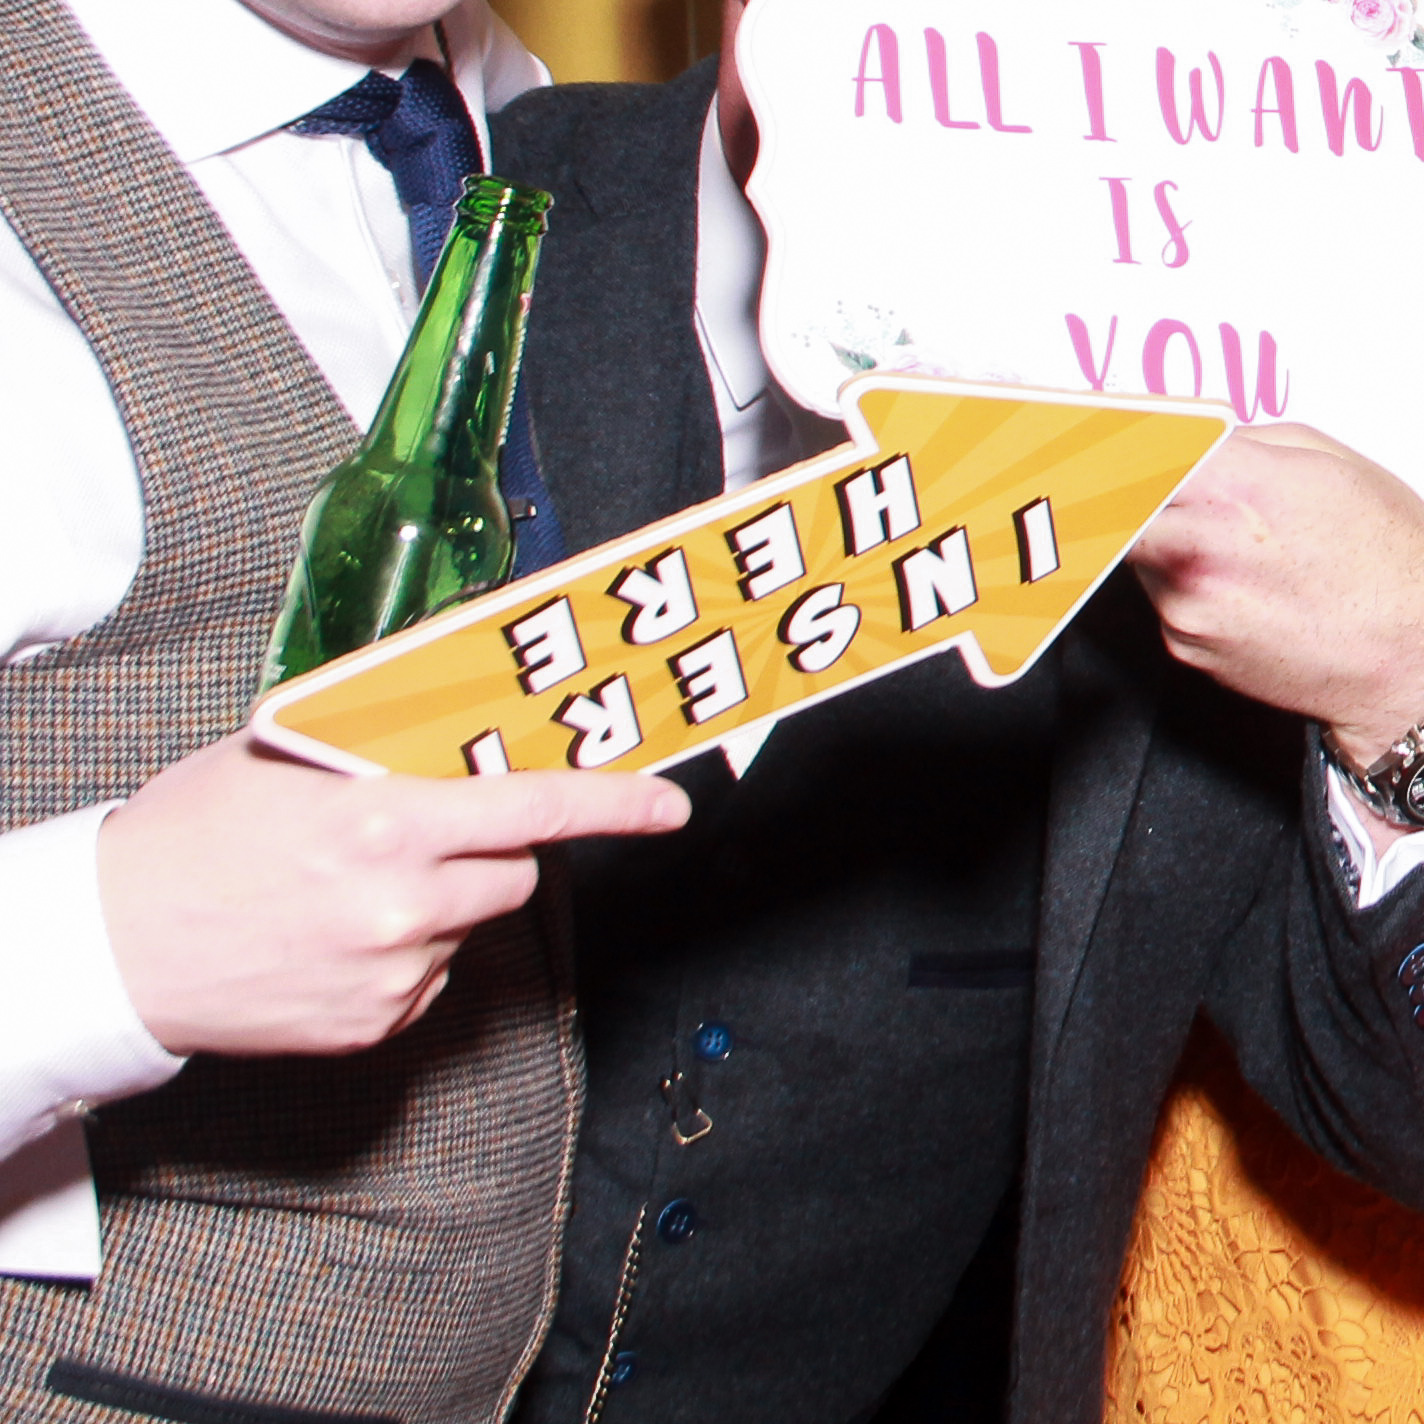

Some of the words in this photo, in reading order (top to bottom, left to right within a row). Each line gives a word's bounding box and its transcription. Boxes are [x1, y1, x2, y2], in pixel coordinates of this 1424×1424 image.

[852, 23, 1032, 134] ALL
[1067, 41, 1118, 143] I
[1099, 176, 1194, 268] IS
[1065, 312, 1290, 424] YOU
[502, 453, 920, 695] HERE
